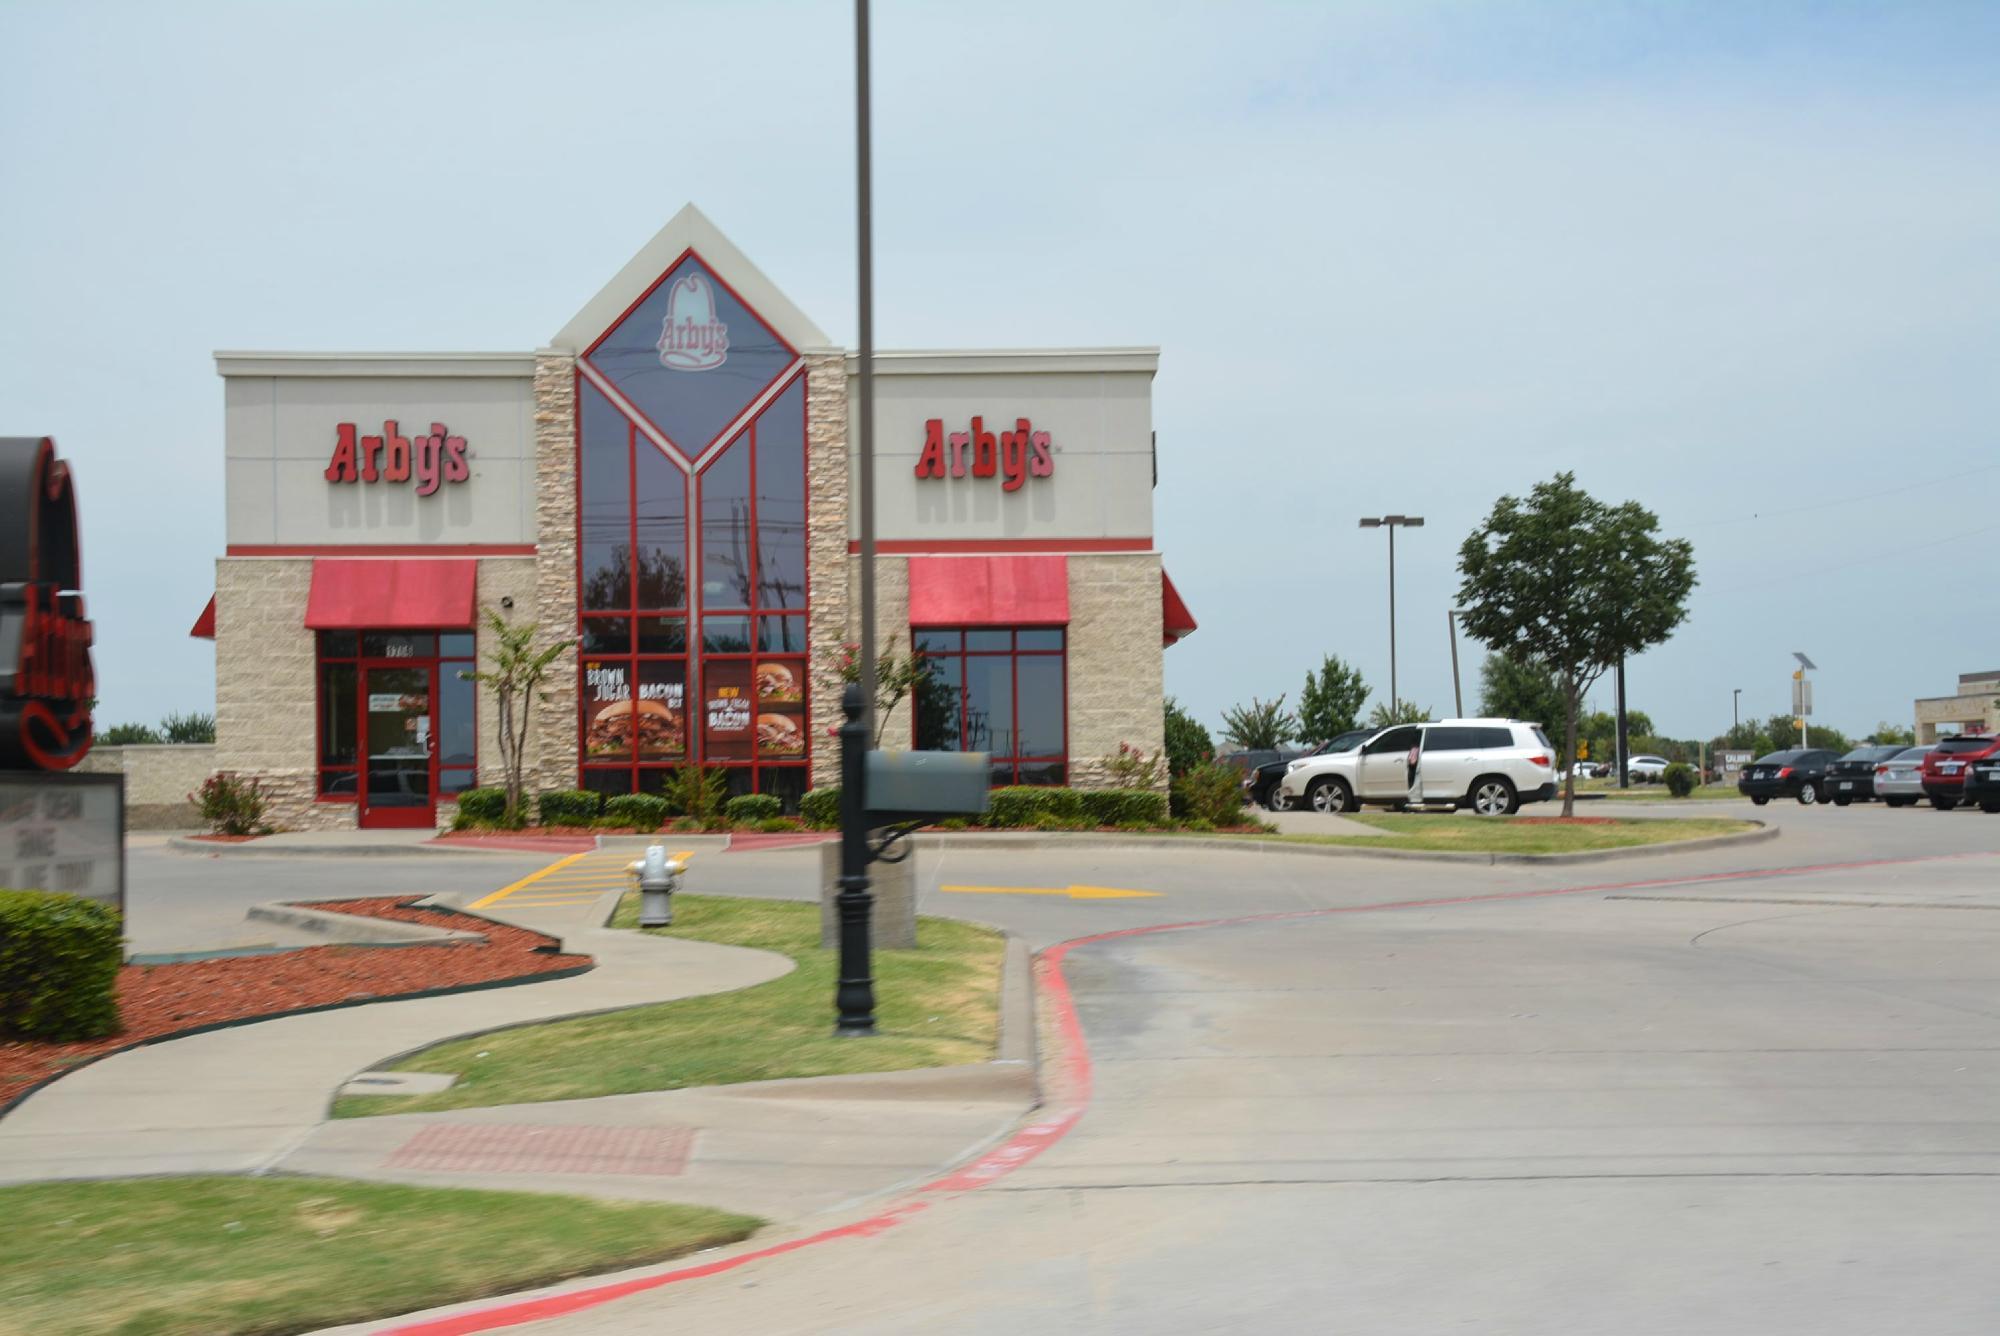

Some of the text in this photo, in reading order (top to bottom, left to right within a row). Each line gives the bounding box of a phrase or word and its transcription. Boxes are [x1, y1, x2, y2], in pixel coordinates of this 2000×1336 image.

[658, 316, 728, 357] Arby's
[325, 419, 470, 497] Arby's
[914, 416, 1054, 492] Arby's
[586, 668, 624, 686] BROWN
[638, 683, 683, 700] BACON
[708, 711, 750, 728] BACON
